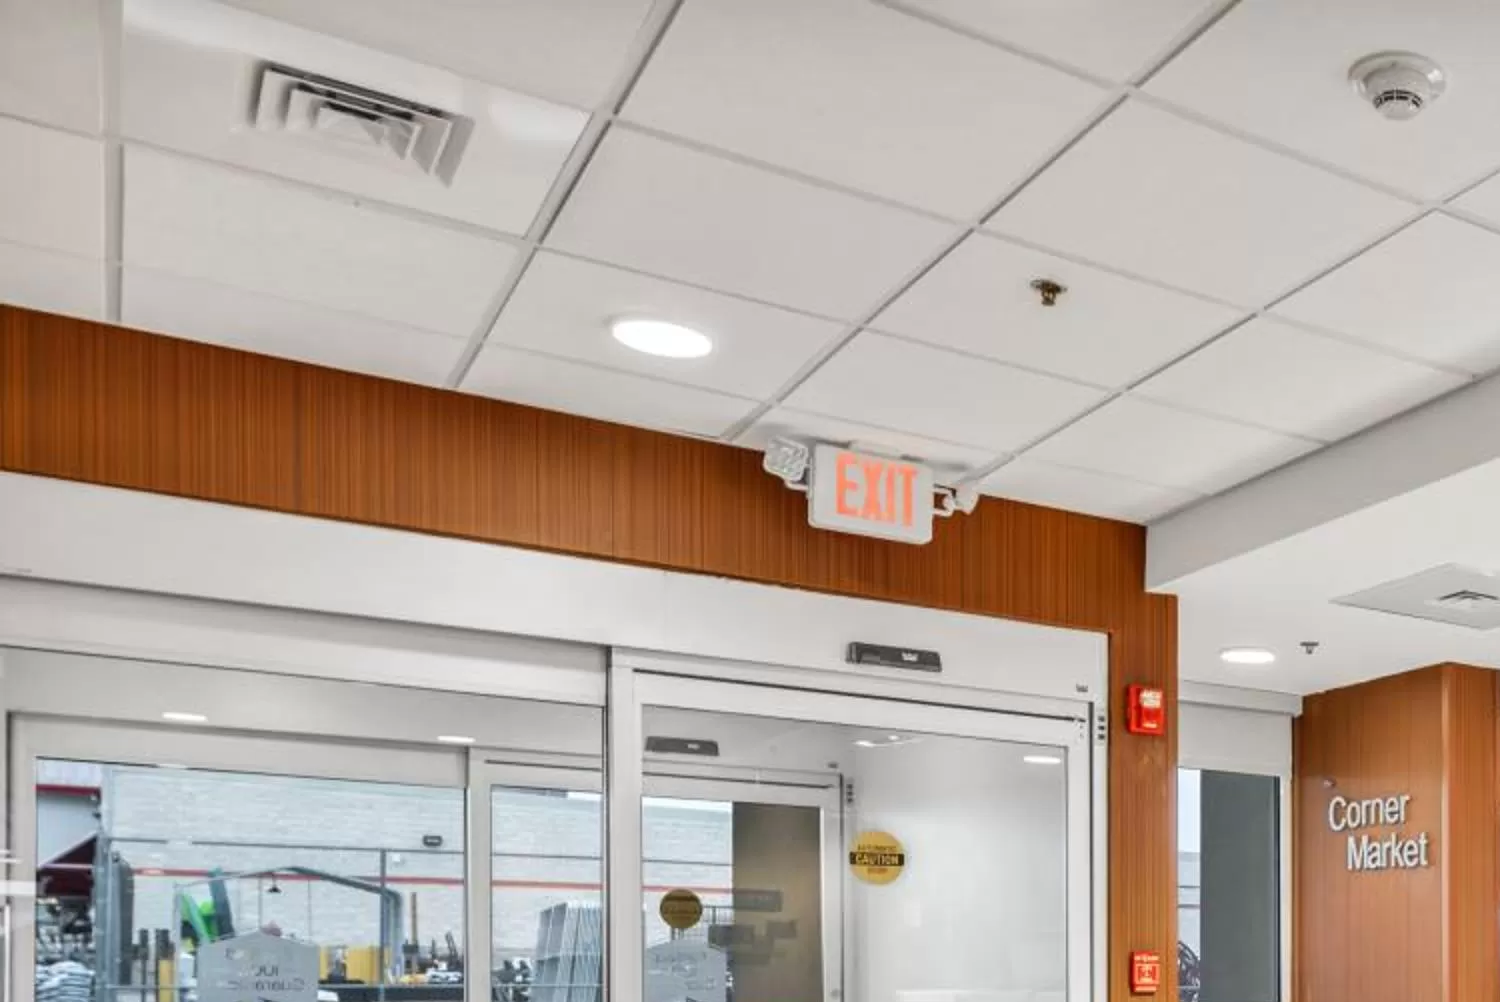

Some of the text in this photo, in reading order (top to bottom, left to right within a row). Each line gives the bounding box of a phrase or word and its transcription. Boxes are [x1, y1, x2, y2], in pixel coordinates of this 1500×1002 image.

[835, 451, 919, 527] EXIT
[1328, 794, 1410, 832] Corner
[855, 853, 899, 866] CAUTION
[1346, 831, 1429, 871] Market
